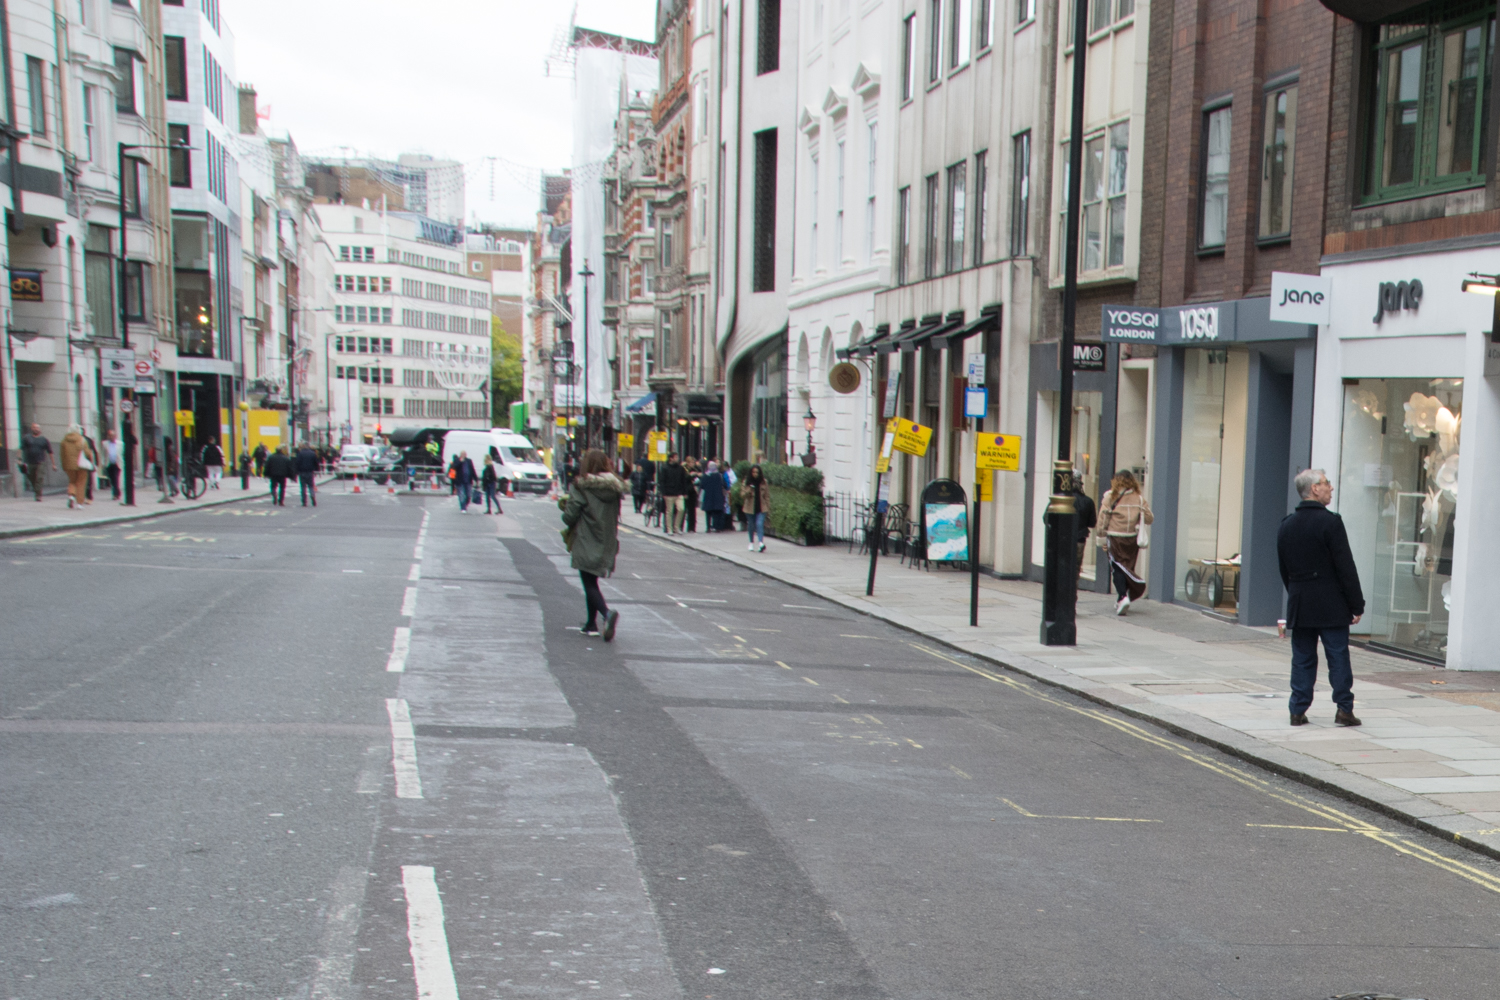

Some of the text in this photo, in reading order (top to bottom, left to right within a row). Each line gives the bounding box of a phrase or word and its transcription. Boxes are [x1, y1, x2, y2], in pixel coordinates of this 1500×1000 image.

[1107, 310, 1159, 328] YOSQI
[1179, 307, 1219, 341] YOSQI
[1109, 327, 1155, 340] LONDON
[899, 433, 926, 447] WARNING
[980, 450, 1017, 460] WARNING
